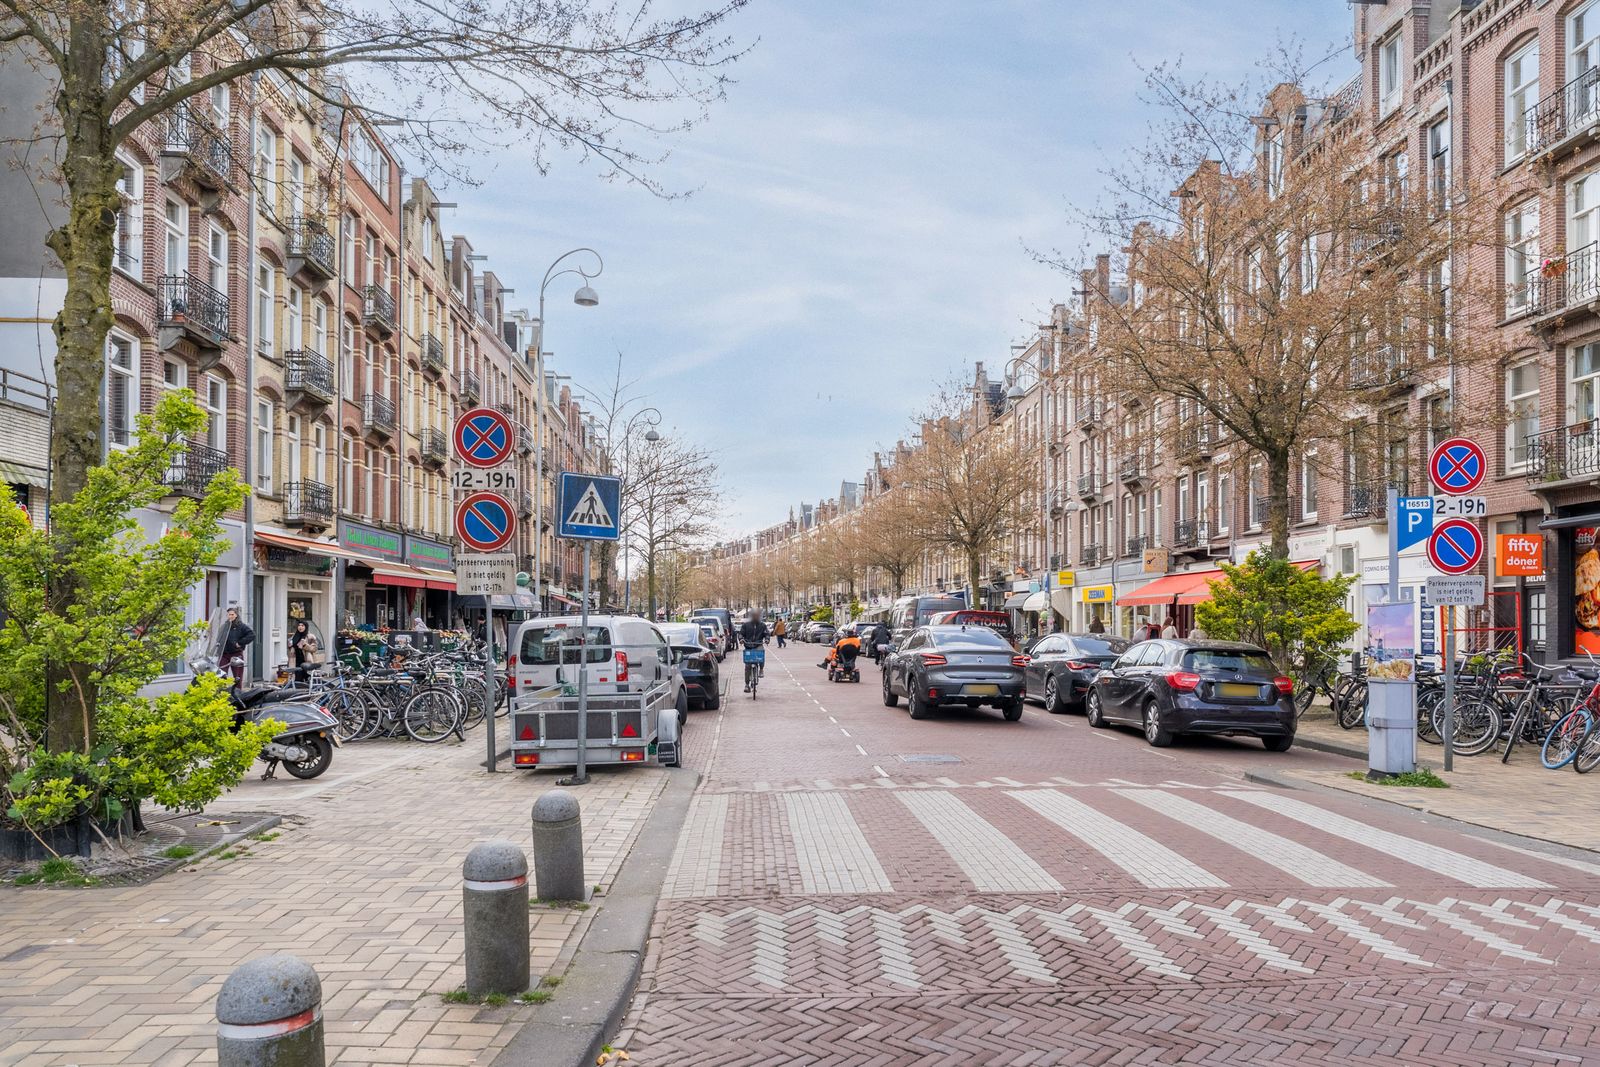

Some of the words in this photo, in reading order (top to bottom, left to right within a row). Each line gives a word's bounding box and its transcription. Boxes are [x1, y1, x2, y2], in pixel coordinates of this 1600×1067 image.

[454, 471, 515, 488] 12-19h
[1407, 500, 1429, 508] 16513
[1436, 499, 1485, 514] 2-19h
[1408, 512, 1423, 532] P
[1508, 538, 1538, 555] fifty
[1506, 556, 1538, 566] döner
[487, 571, 505, 581] geldig
[1428, 579, 1482, 587] Parkeervergunning
[1088, 589, 1105, 599] ZEEMAN
